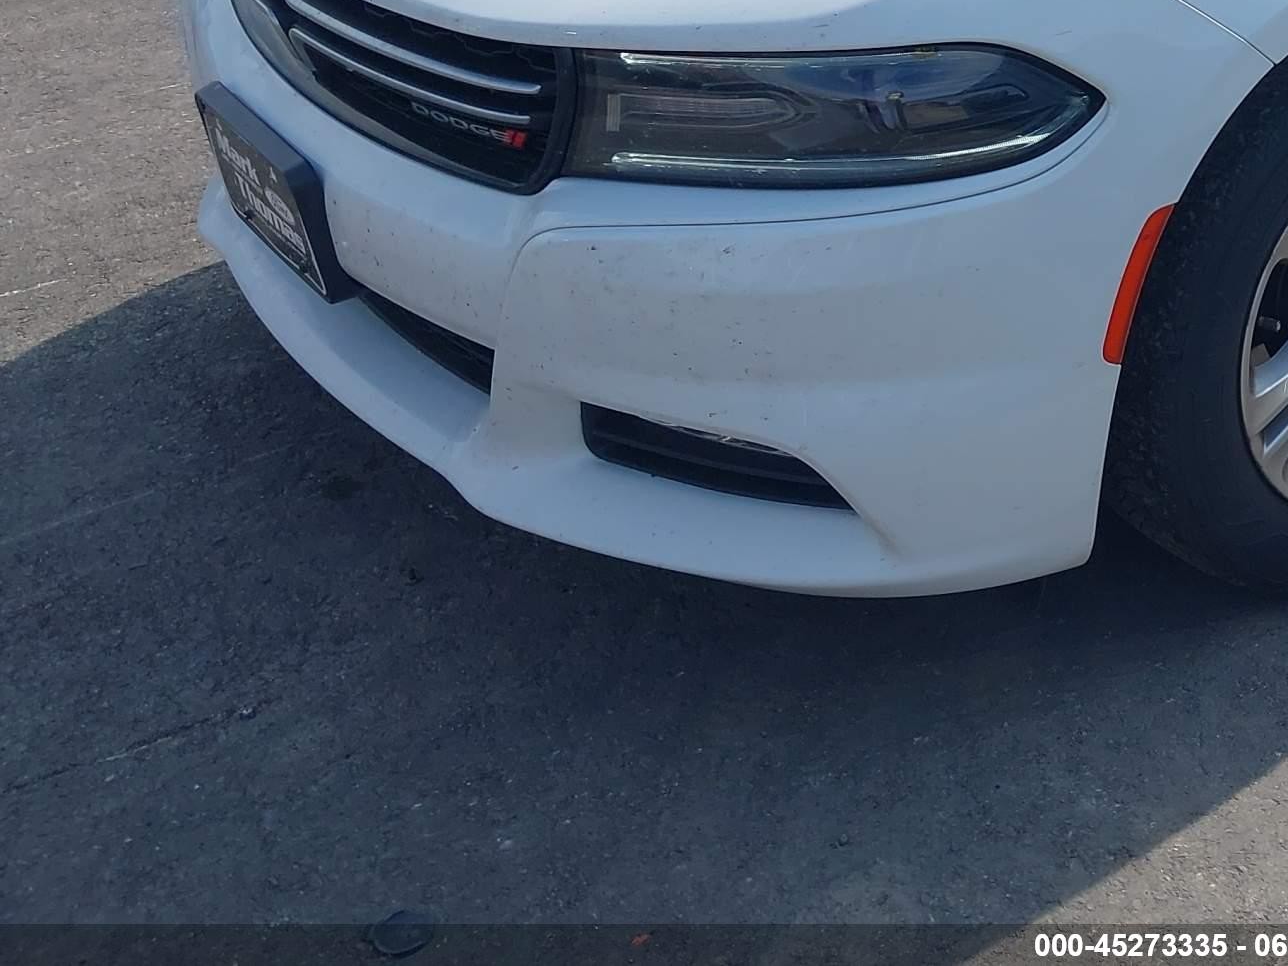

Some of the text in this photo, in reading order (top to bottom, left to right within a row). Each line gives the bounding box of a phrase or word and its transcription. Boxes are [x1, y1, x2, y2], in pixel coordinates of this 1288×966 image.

[410, 100, 514, 144] DODGE
[215, 127, 261, 184] Mark
[234, 170, 307, 256] Thomas
